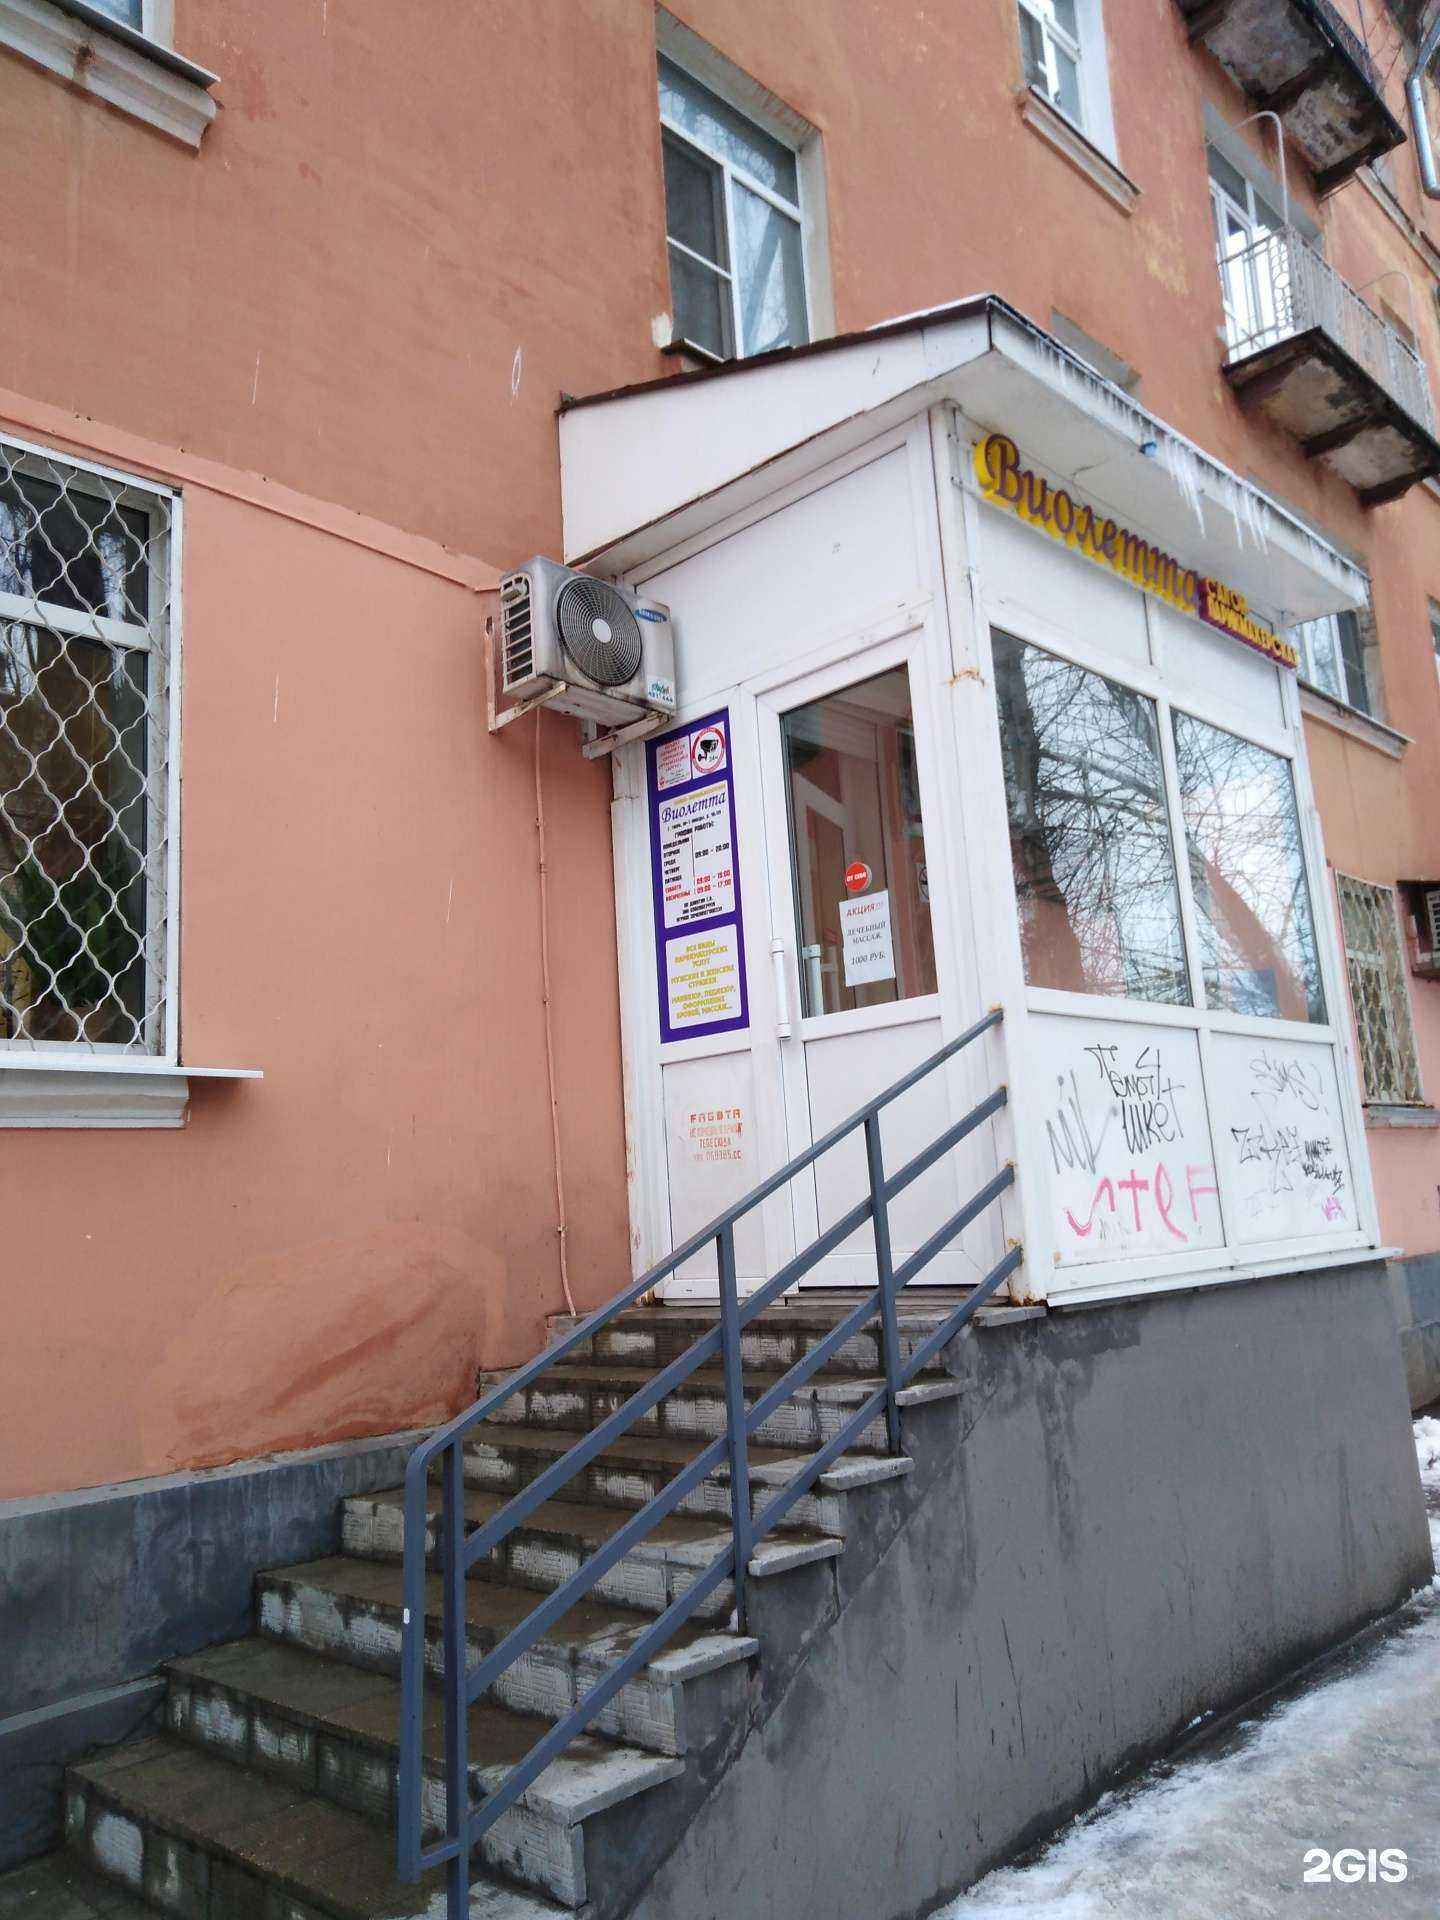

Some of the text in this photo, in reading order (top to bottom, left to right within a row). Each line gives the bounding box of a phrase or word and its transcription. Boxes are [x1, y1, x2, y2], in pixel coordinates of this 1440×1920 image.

[974, 432, 1200, 618] Виолетта
[662, 792, 726, 823] Виолетта
[695, 821, 714, 832] РАБОТЫ:
[664, 848, 680, 858] ВТОРНИК
[664, 859, 676, 867] СРЕДА
[664, 866, 681, 875] ЧЕТВЕРГ
[854, 871, 867, 880] СЕБЯ
[665, 875, 682, 885] ПЯТНИЦА
[848, 920, 886, 936] ЛЕЧЕБНЫЙ
[851, 950, 887, 967] 1000 РУБ.
